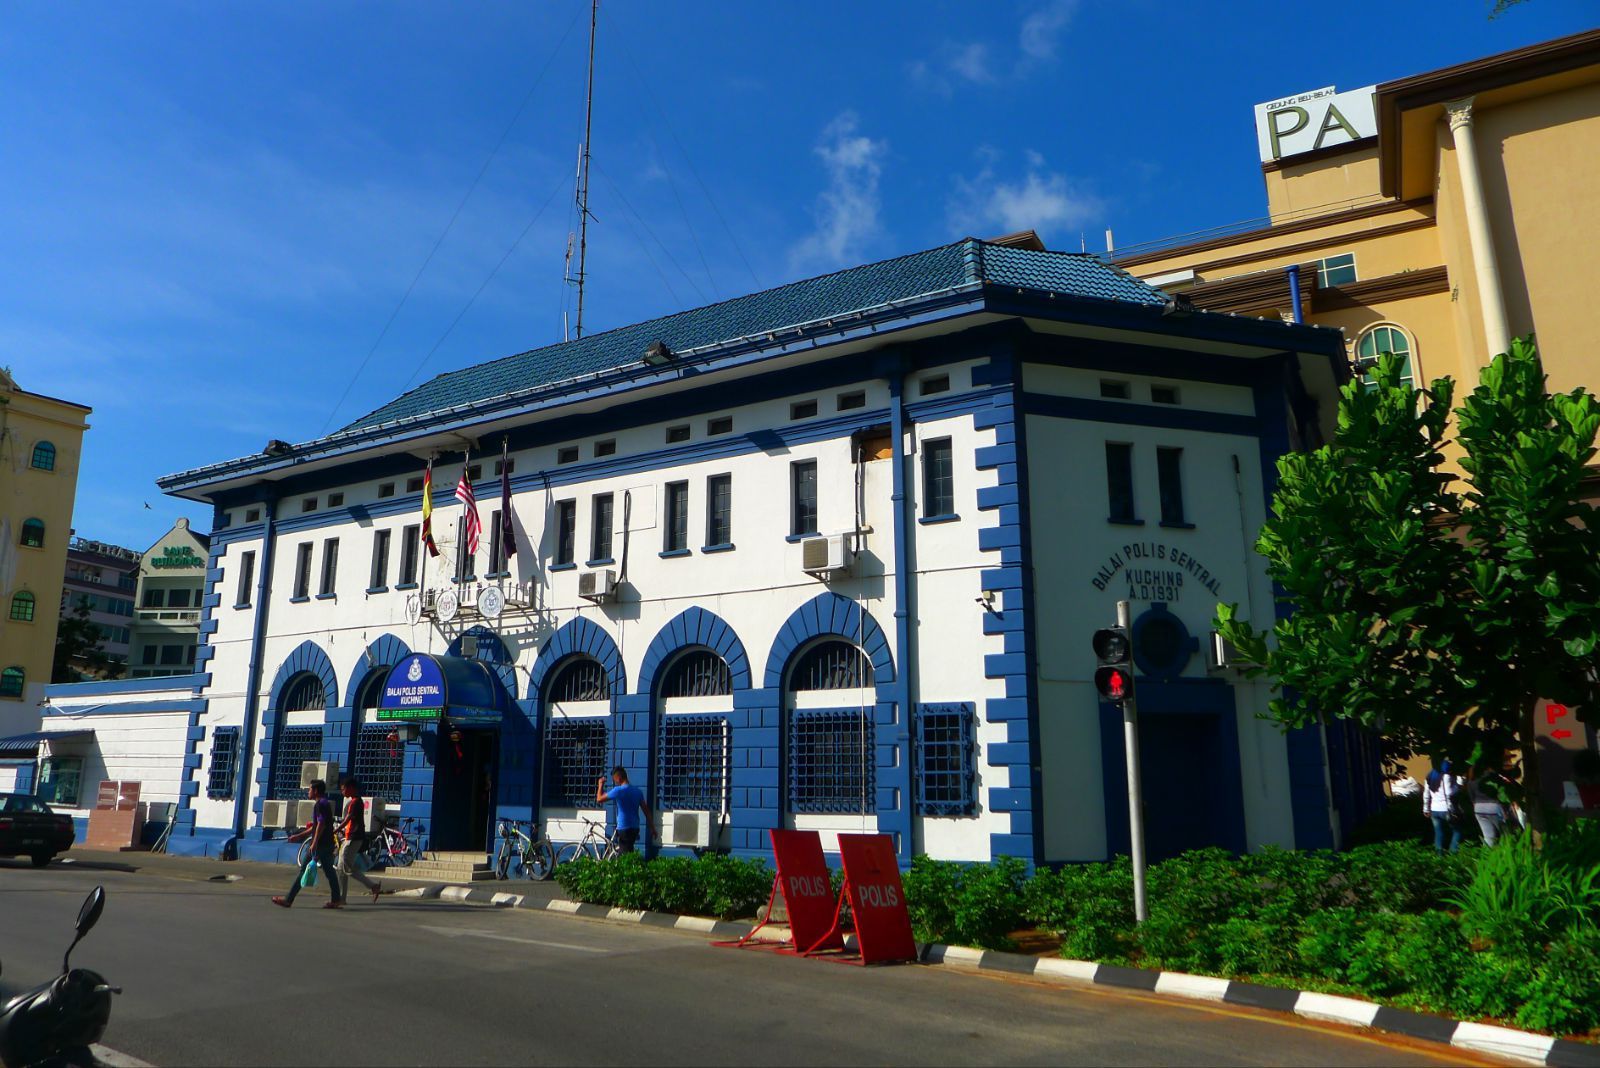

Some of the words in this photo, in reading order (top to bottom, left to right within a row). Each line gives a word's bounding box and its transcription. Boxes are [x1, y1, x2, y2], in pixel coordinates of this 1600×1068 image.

[1267, 92, 1378, 160] PA
[1092, 553, 1124, 591] BALAI
[1123, 542, 1166, 560] POLIS
[1169, 548, 1222, 597] SENTRAL
[1125, 568, 1184, 587] KUCHING
[387, 687, 402, 696] BALAI
[402, 686, 416, 696] POLIS
[417, 685, 439, 695] SENTRAL
[400, 696, 423, 705] KUCHING
[1545, 703, 1567, 725] P
[789, 876, 827, 897] POLIS
[858, 884, 898, 908] POLIS
